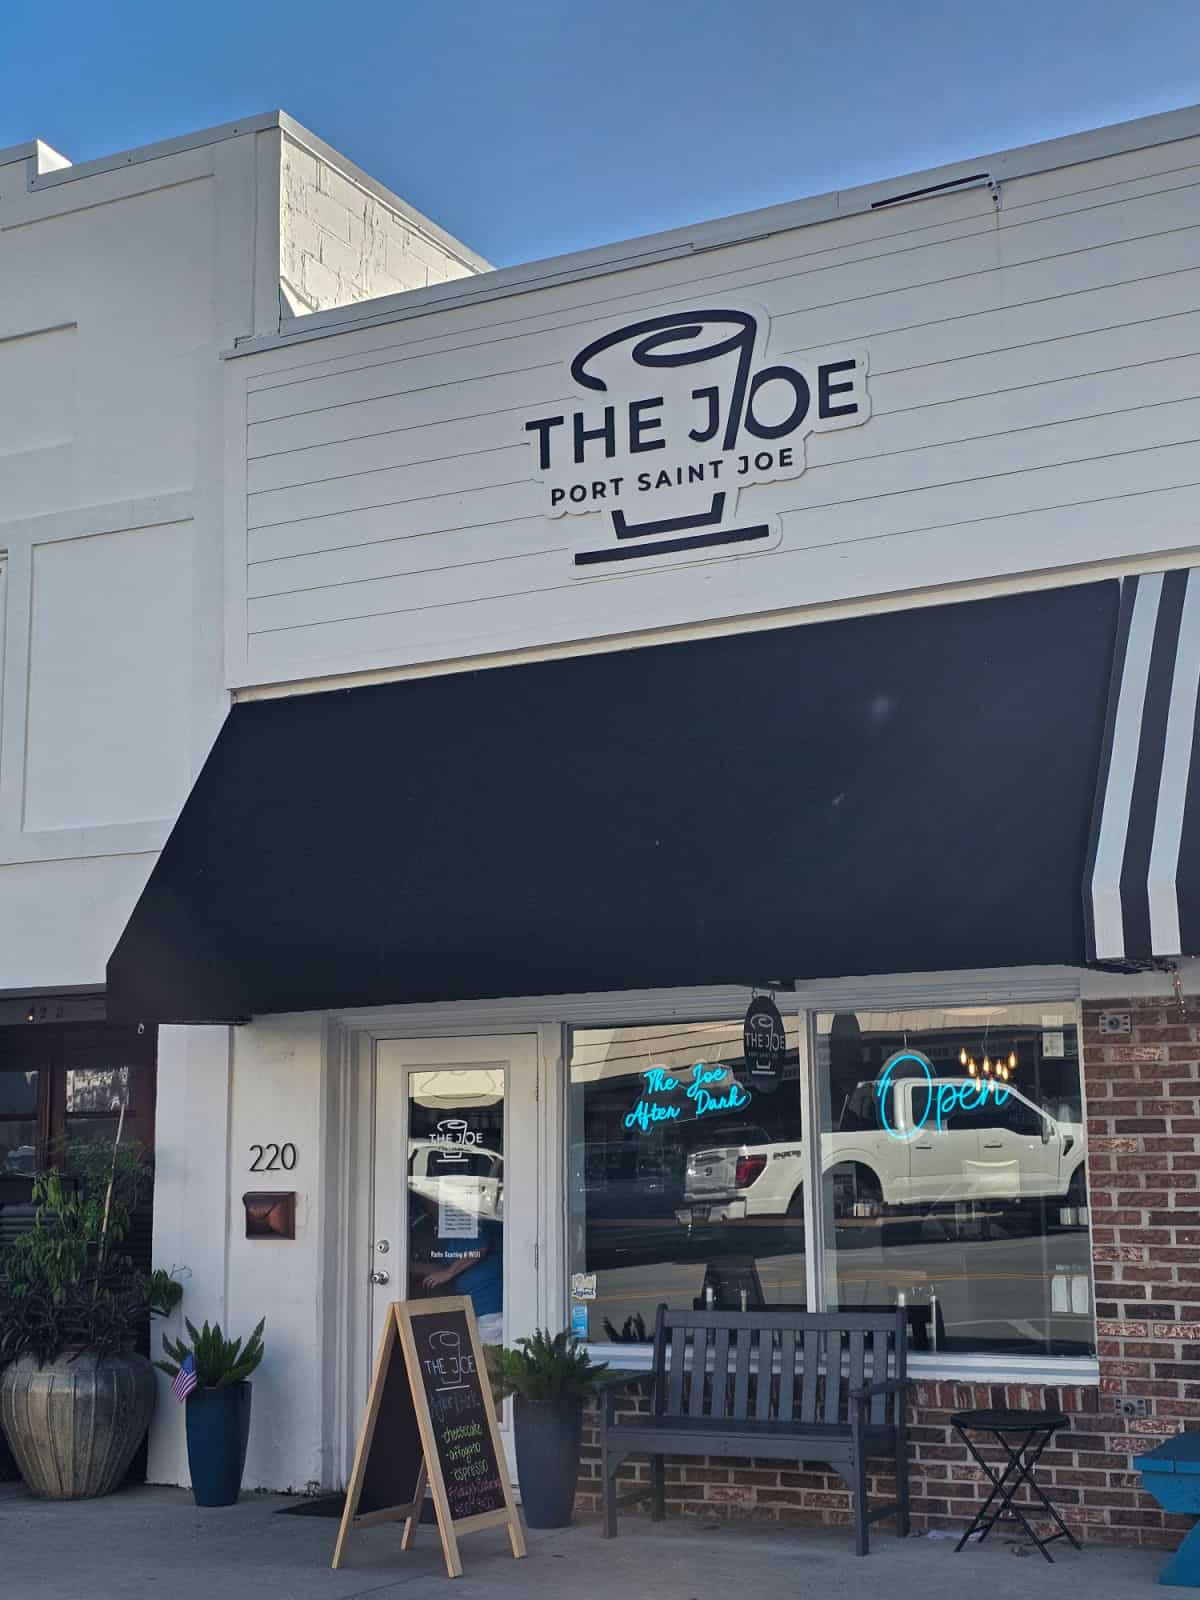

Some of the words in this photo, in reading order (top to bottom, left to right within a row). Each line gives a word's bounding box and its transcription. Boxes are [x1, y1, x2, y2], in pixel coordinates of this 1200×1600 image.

[525, 397, 666, 470] THE
[688, 359, 858, 441] JOE
[551, 477, 624, 506] PORT
[637, 460, 723, 491] SAINT
[737, 447, 793, 474] JOE
[745, 1032, 762, 1048] THE
[765, 1033, 785, 1051] JOE
[644, 1068, 678, 1094] The
[687, 1064, 728, 1097] Joe
[877, 1055, 1009, 1139] Open
[625, 1101, 680, 1130] After
[695, 1086, 746, 1115] Dark
[428, 1133, 453, 1145] THE
[455, 1132, 483, 1145] JOE
[249, 1142, 297, 1172] 220
[423, 1358, 447, 1375] THE
[449, 1355, 476, 1374] JOE
